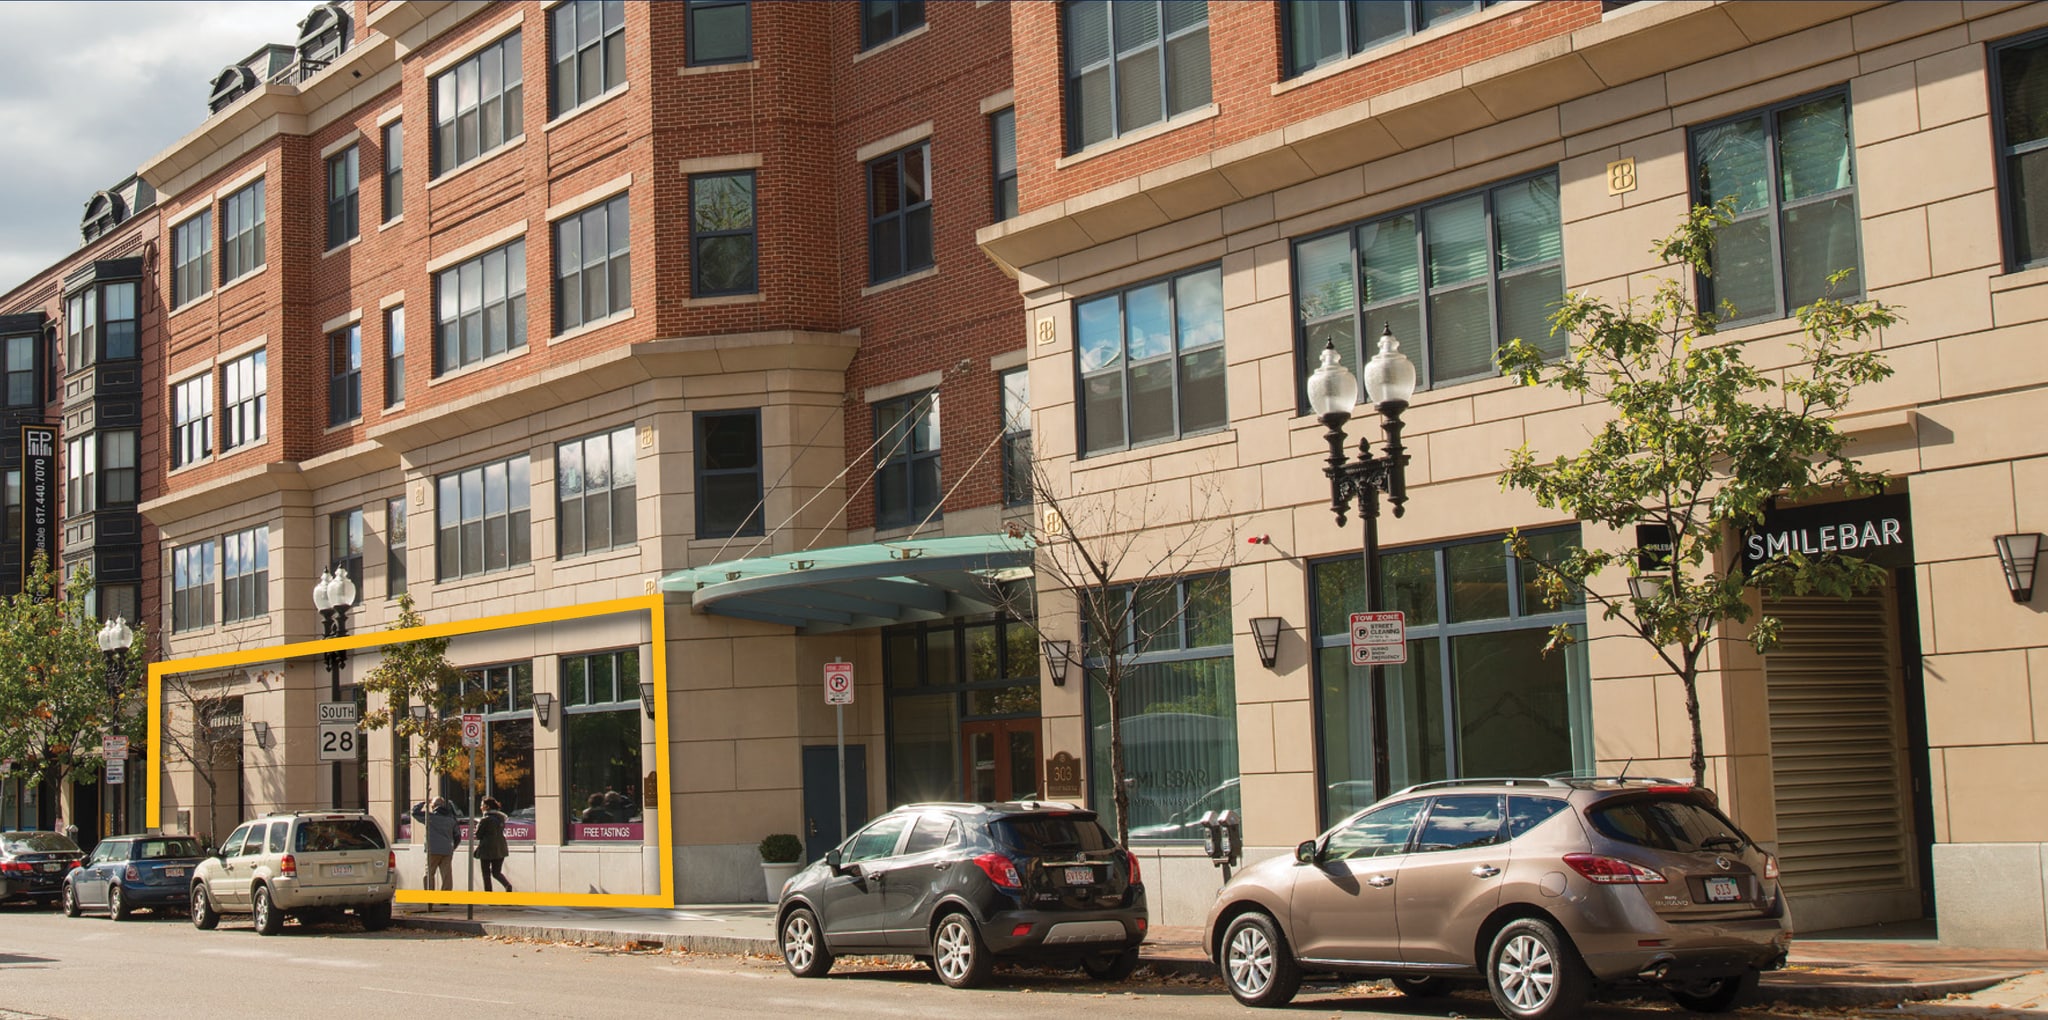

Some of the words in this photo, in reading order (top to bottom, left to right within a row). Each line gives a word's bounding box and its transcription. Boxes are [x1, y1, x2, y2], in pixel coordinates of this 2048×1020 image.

[35, 458, 45, 524] 617.440.7070
[1748, 518, 1903, 560] SMILEBAR
[321, 705, 355, 719] SOUTH
[322, 731, 353, 752] 28
[1054, 766, 1073, 781] 303
[583, 827, 599, 838] FREE
[600, 827, 630, 838] TASTINGS
[1715, 883, 1731, 896] 613
